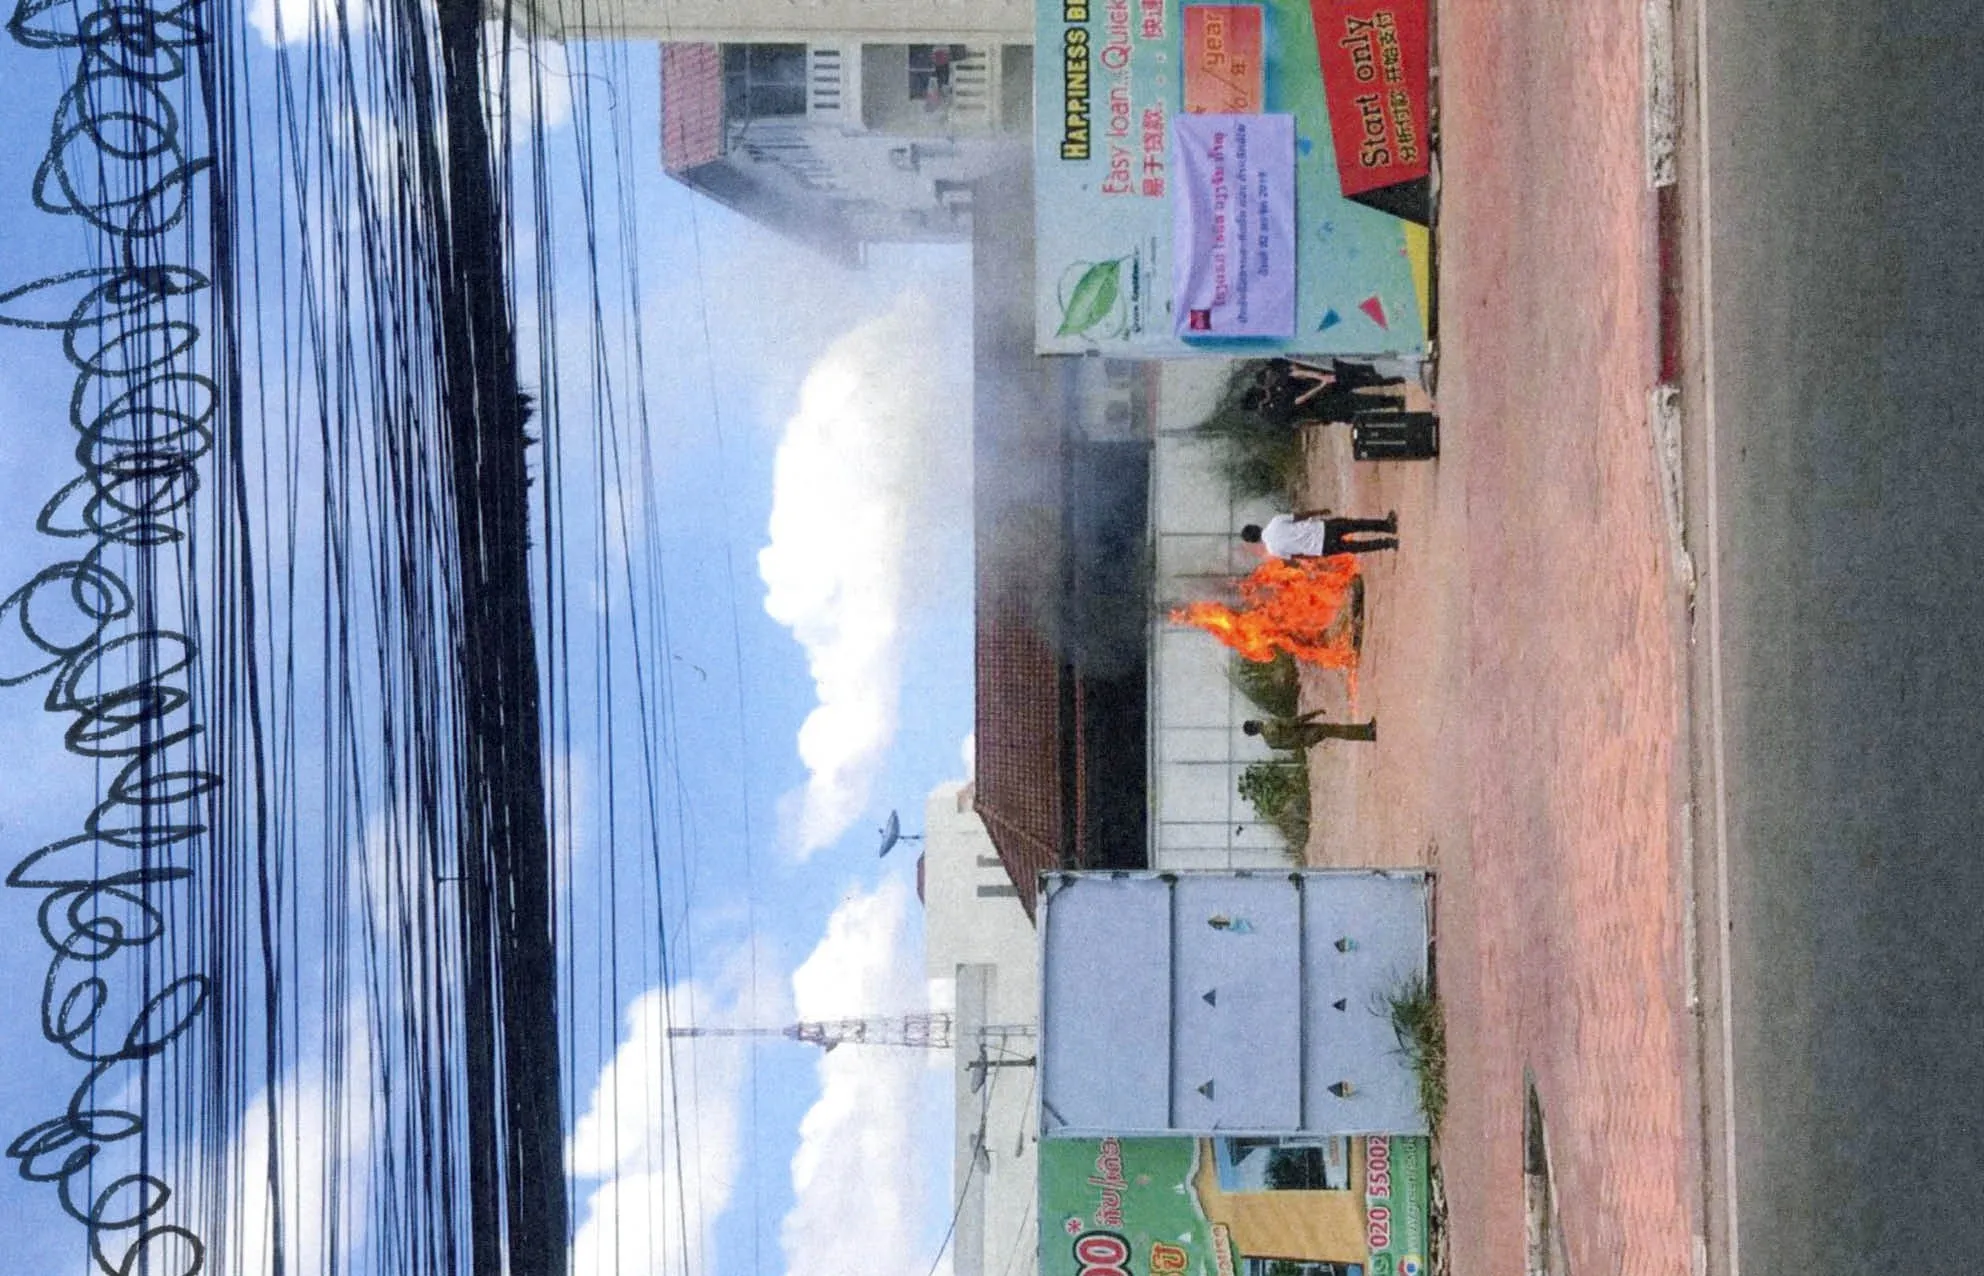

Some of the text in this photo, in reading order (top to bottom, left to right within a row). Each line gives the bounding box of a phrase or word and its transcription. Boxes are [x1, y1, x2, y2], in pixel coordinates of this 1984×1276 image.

[1205, 13, 1225, 66] year
[1060, 28, 1089, 159] HAPPINESS
[1341, 16, 1390, 167] Start only
[1100, 145, 1134, 194] Easy
[1368, 1207, 1388, 1248] 020
